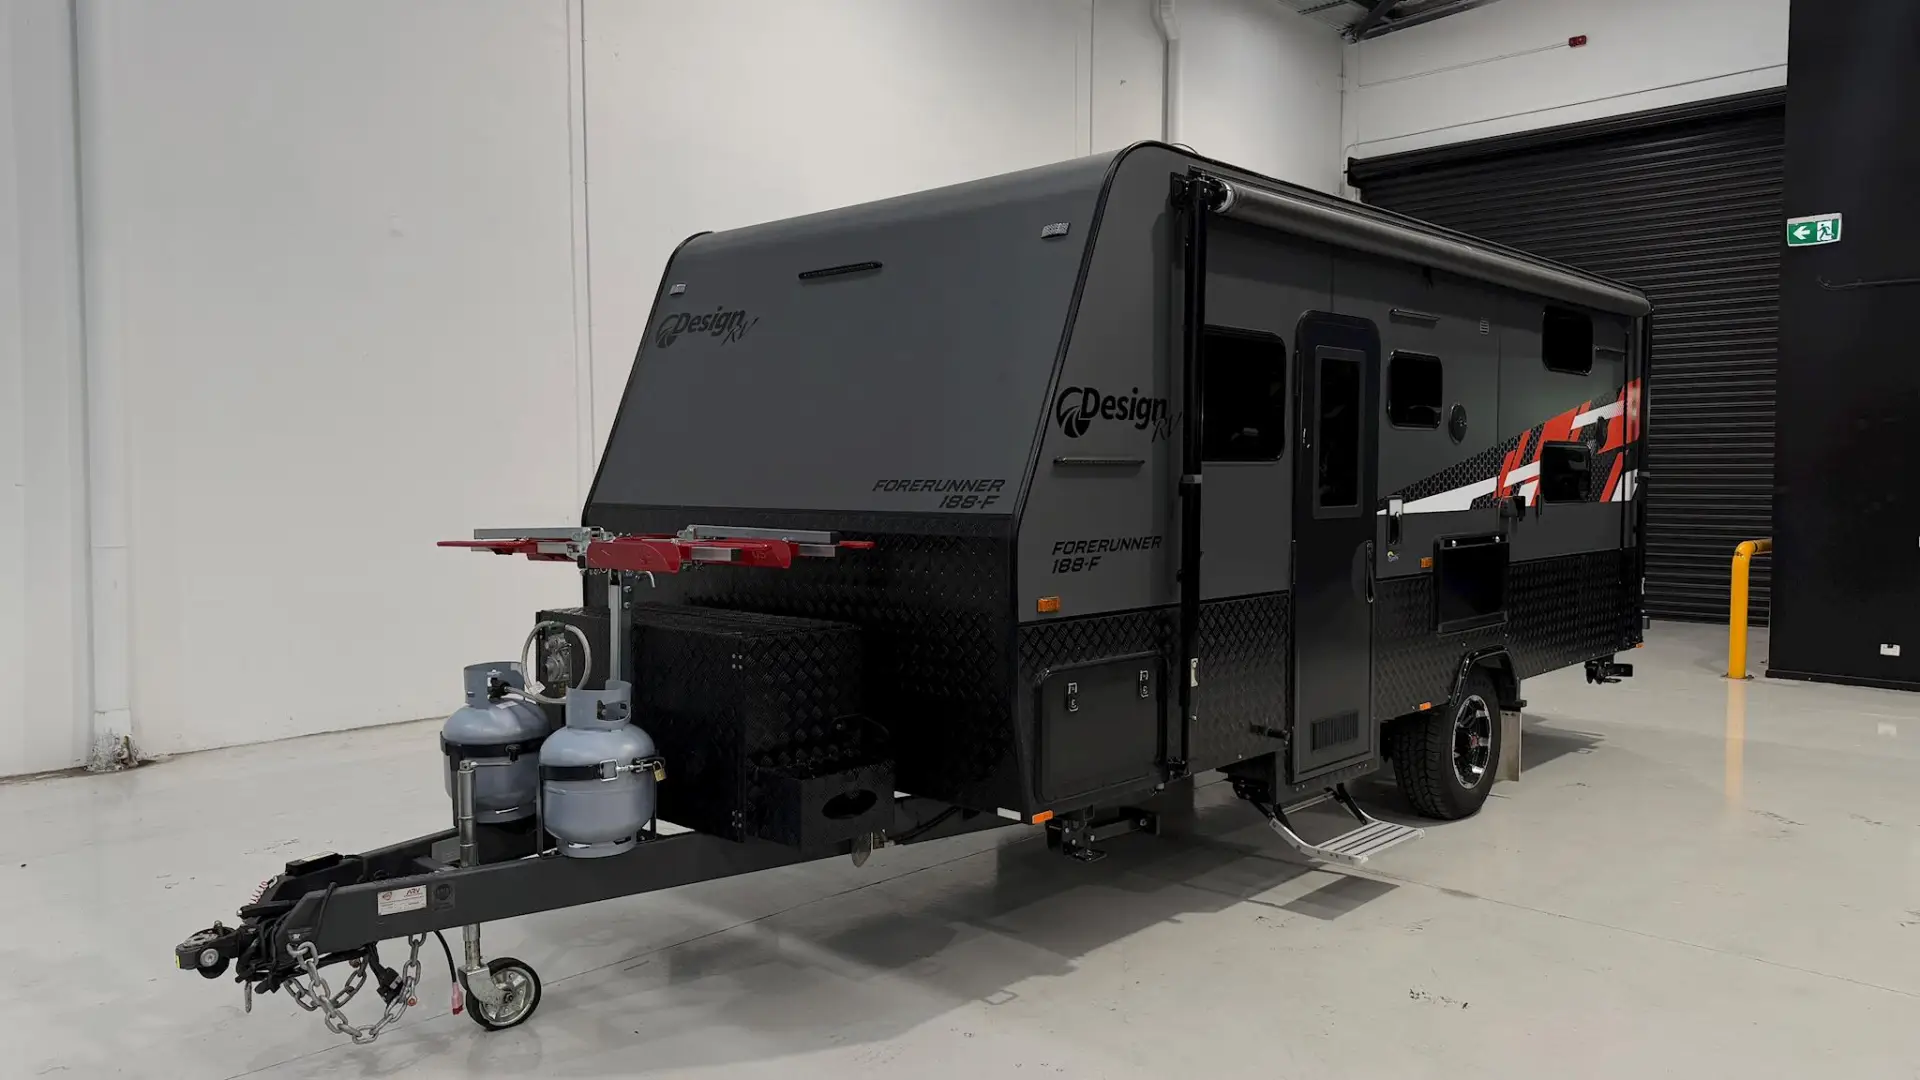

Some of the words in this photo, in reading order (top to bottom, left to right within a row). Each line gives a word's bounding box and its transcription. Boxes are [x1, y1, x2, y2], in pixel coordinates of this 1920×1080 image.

[673, 305, 746, 337] Design
[1079, 386, 1167, 430] Design
[872, 479, 1006, 492] FORERUNNER
[1051, 535, 1162, 556] FORERUNNER
